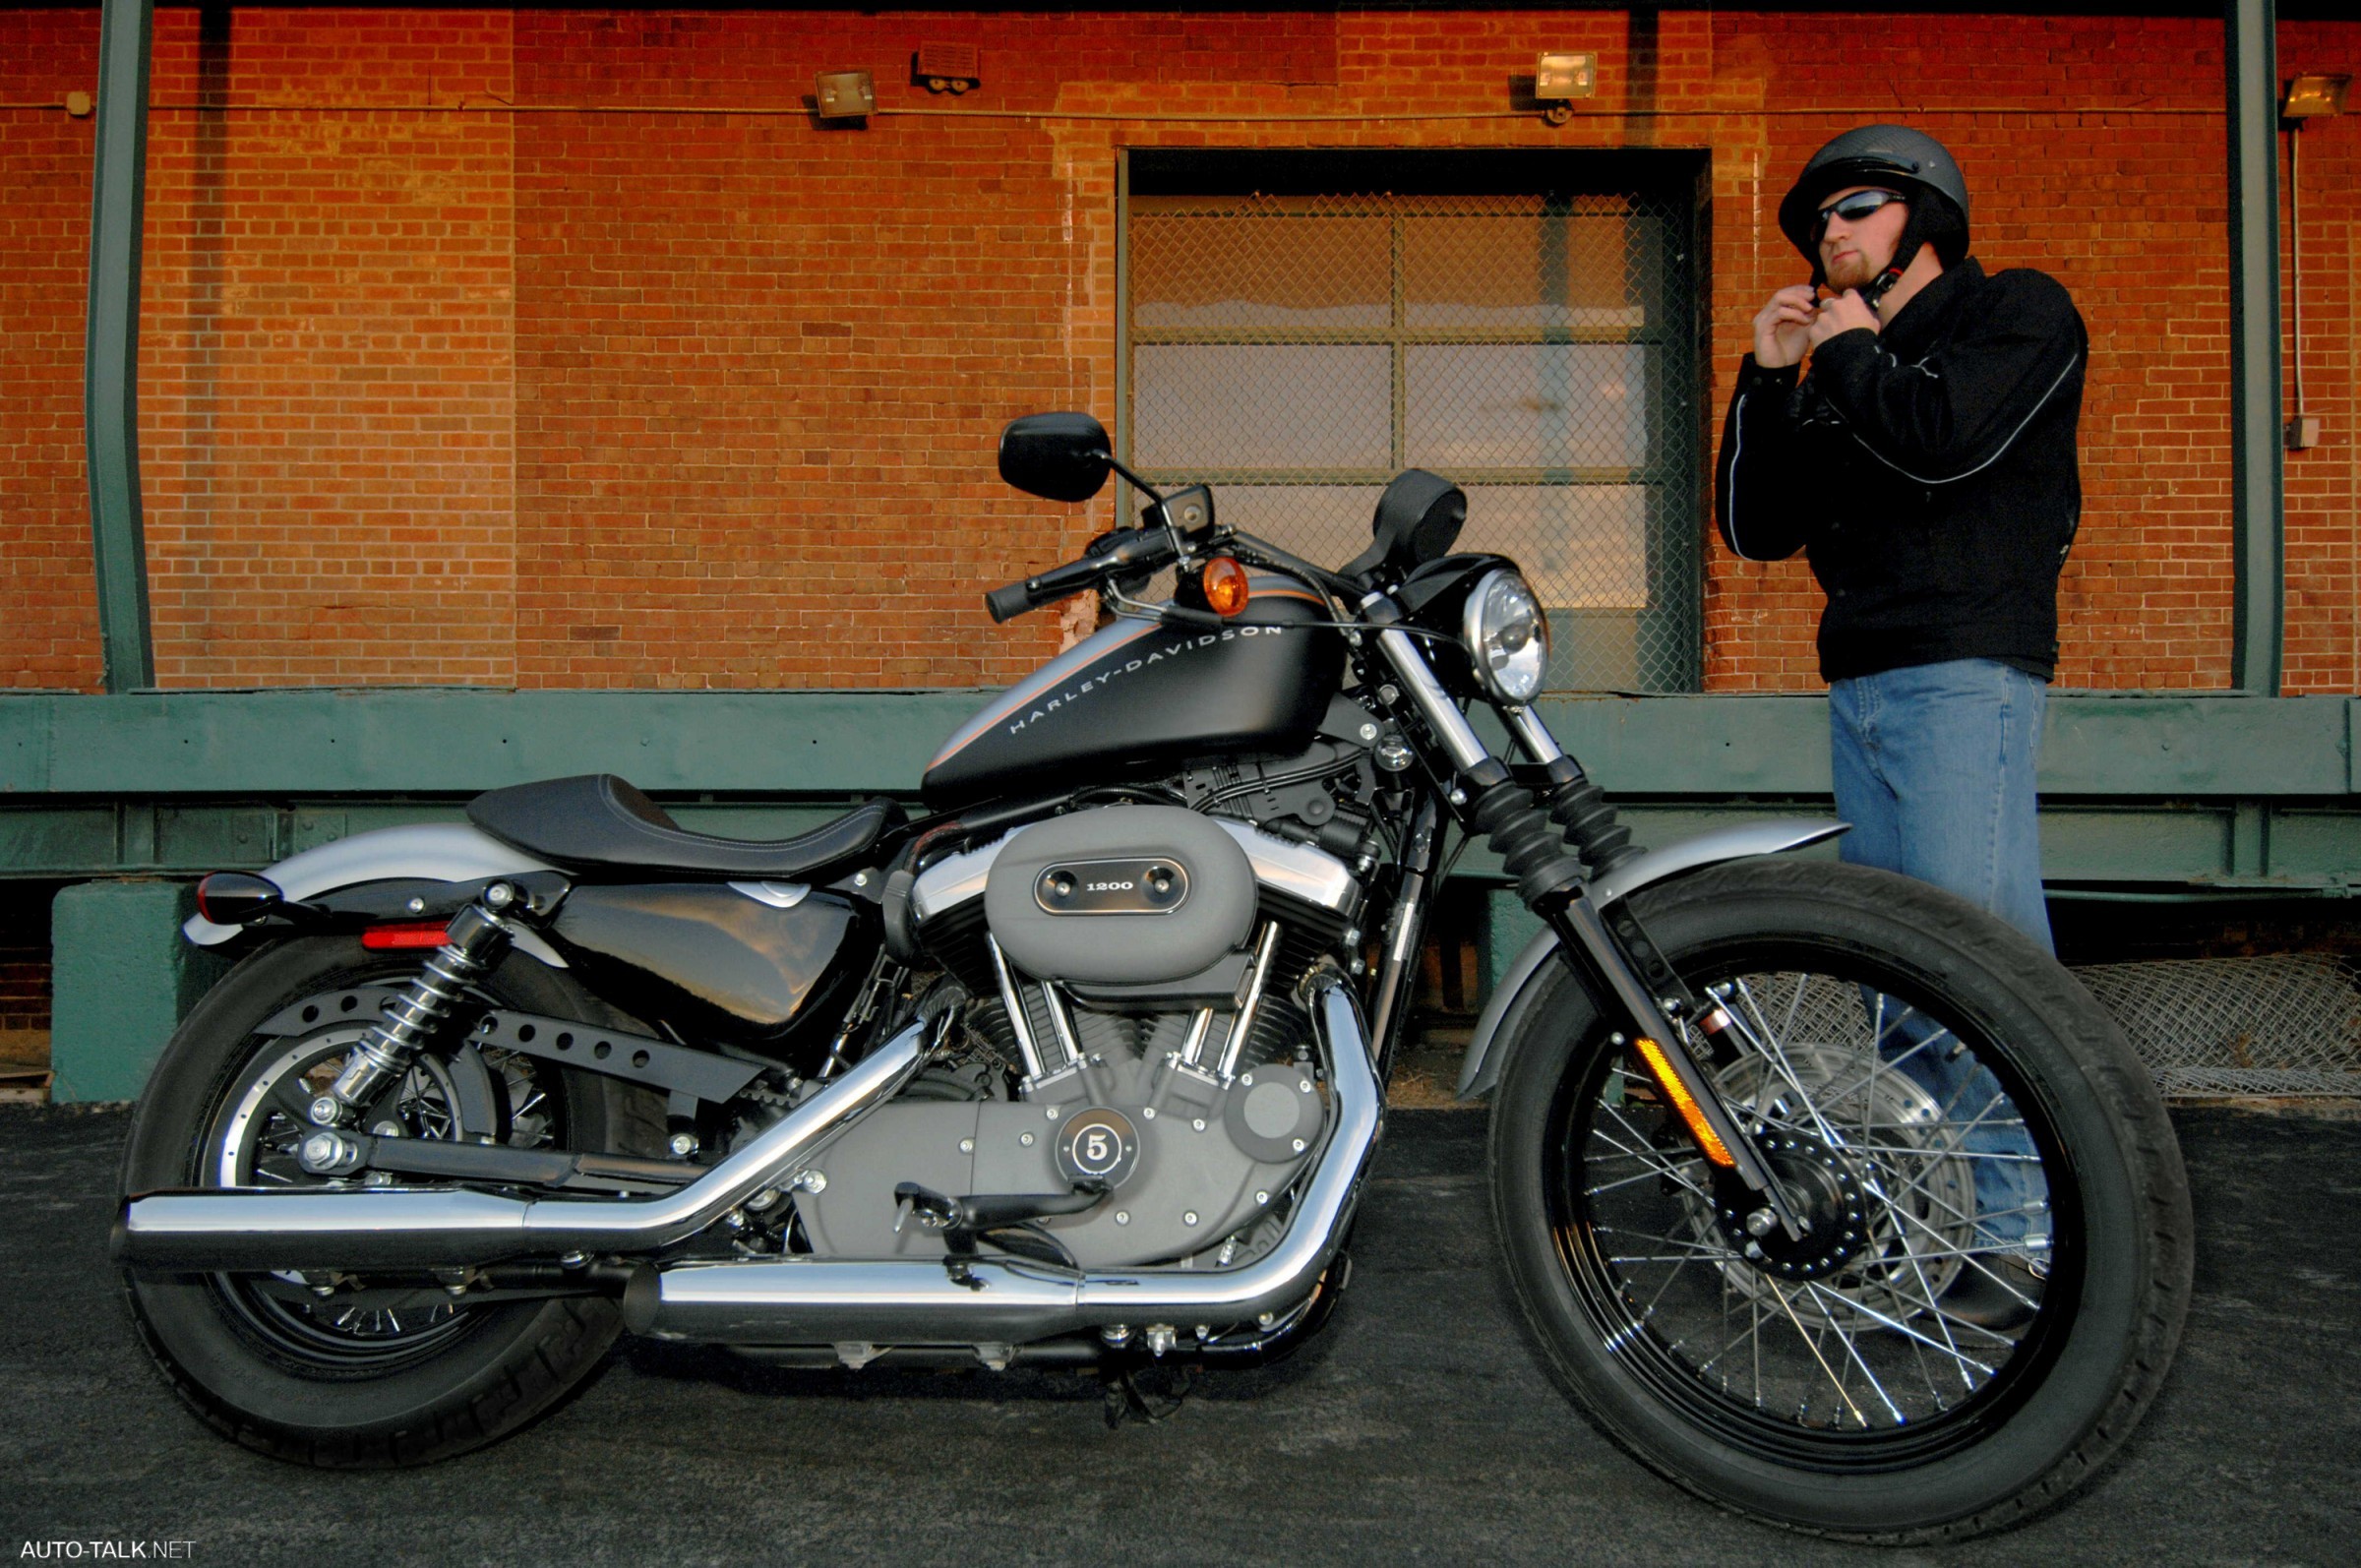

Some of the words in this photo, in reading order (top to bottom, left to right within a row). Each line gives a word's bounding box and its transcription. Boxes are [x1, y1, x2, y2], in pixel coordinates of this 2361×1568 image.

[1009, 626, 1282, 735] HARLEY-DAVIDSON
[1086, 880, 1133, 891] 1200
[1086, 1134, 1108, 1161] 5
